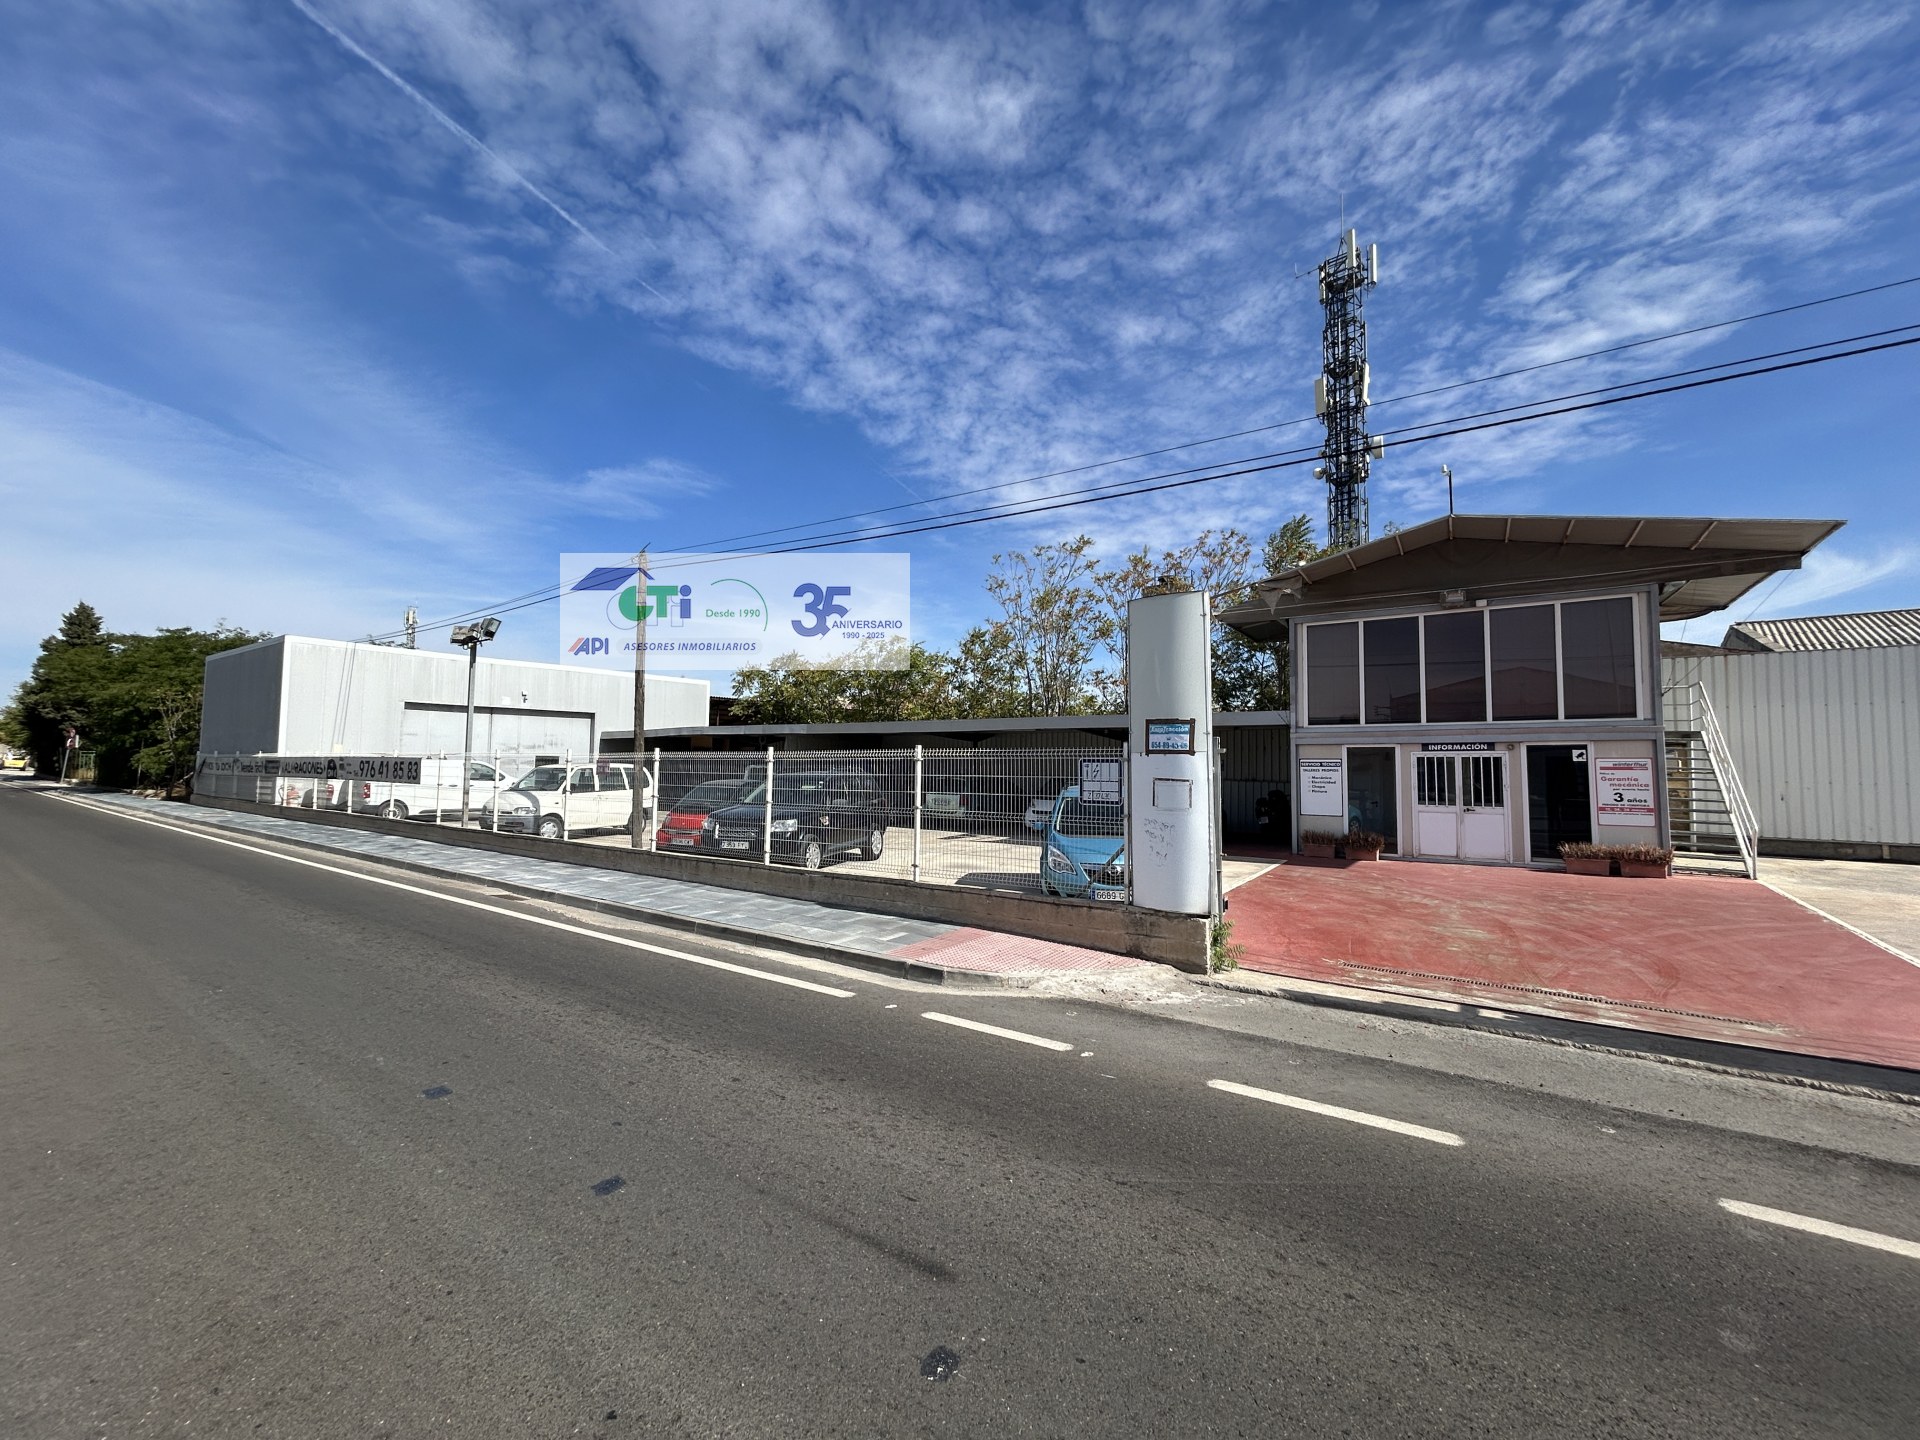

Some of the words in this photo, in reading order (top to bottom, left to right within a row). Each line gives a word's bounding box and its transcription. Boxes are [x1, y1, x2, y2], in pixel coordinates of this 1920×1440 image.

[360, 760, 376, 778] 976
[378, 760, 389, 779] 41
[392, 761, 404, 780] 85
[407, 761, 419, 780] 83
[1613, 792, 1624, 803] 3
